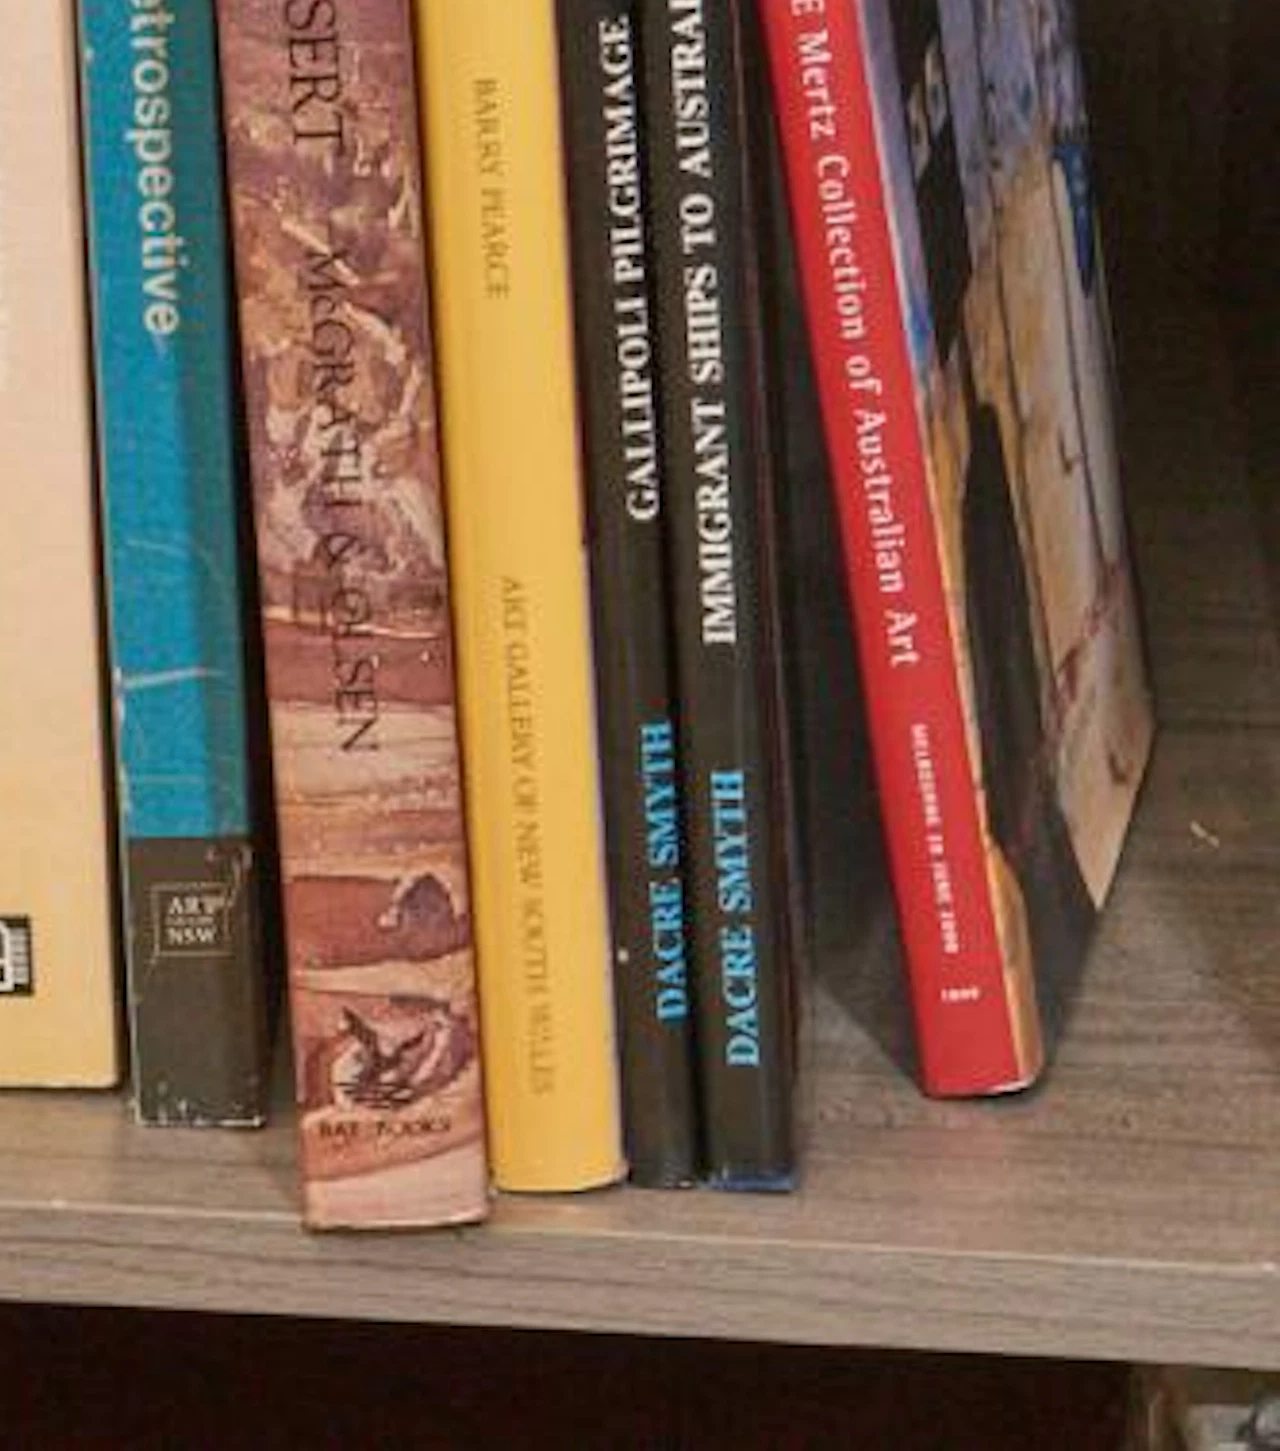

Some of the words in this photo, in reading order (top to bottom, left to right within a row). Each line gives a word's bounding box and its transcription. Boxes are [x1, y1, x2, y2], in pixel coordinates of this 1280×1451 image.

[473, 77, 504, 178] BARRY
[796, 30, 846, 141] Mertz
[598, 14, 646, 283] PILGRIMAGE
[479, 187, 510, 299] PEARCE
[678, 196, 716, 254] TO
[815, 154, 872, 341] Collection
[683, 266, 724, 383] SHIPS
[844, 354, 884, 397] of
[613, 295, 661, 521] GALLIPOLI
[691, 400, 738, 646] IMMIGRANT
[853, 407, 908, 595] Australian
[503, 575, 531, 632] ART
[885, 607, 921, 666] Art
[509, 640, 537, 769] GALLERY
[513, 775, 541, 812] OF
[639, 719, 681, 866] SMYTH
[709, 769, 754, 914] SMYTH
[516, 819, 545, 888] NEW
[167, 926, 218, 946] NSW
[523, 895, 551, 995] SOUTH
[647, 877, 689, 1022] DACRE
[720, 926, 761, 1067] DACRE
